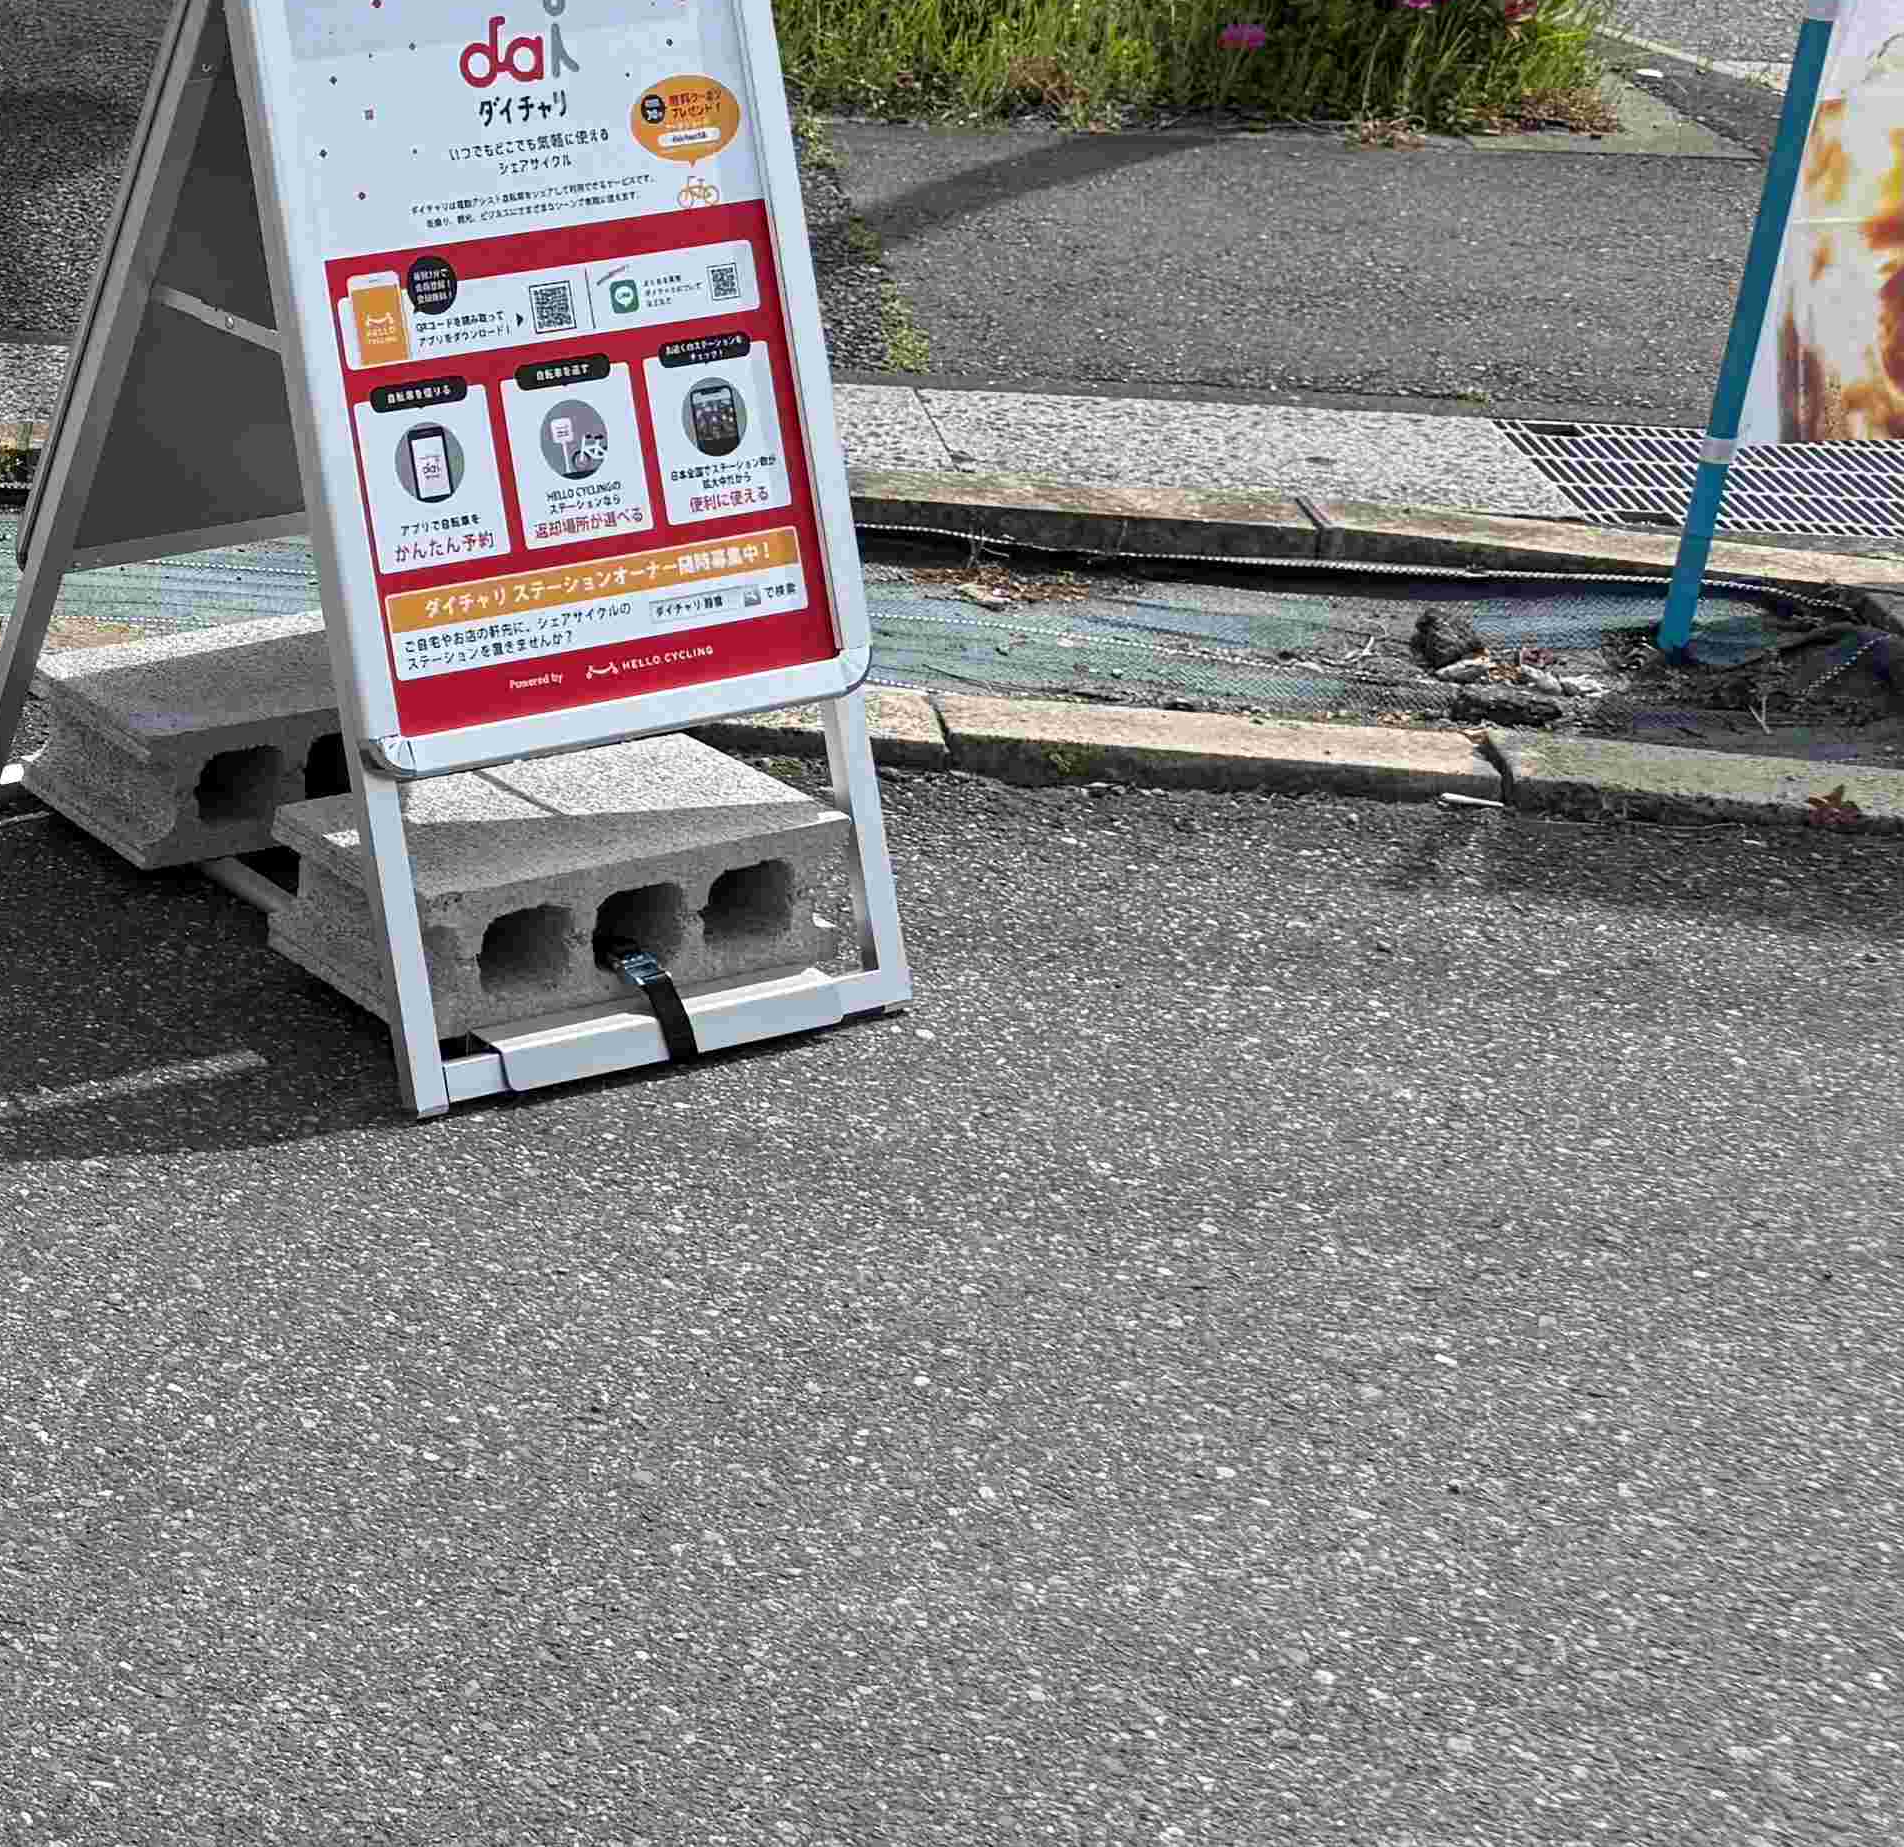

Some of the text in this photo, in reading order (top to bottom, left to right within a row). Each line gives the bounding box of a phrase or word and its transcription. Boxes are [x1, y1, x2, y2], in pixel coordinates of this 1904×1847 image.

[478, 89, 568, 127] ダイチャリ
[449, 127, 610, 161] いつでもどこでも気軽に使える
[498, 154, 572, 176] シェアサイクル
[689, 485, 770, 513] 便利に使える
[400, 514, 482, 534] アプリで自転車を
[533, 506, 643, 540] 返却場所が選べる
[394, 531, 494, 563] かんたん予約
[424, 586, 507, 619] ダイチャリ
[408, 630, 573, 671] ステーションを置きませんか？
[621, 645, 714, 671] HELLO CYCLING
[509, 672, 564, 691] Powered by
